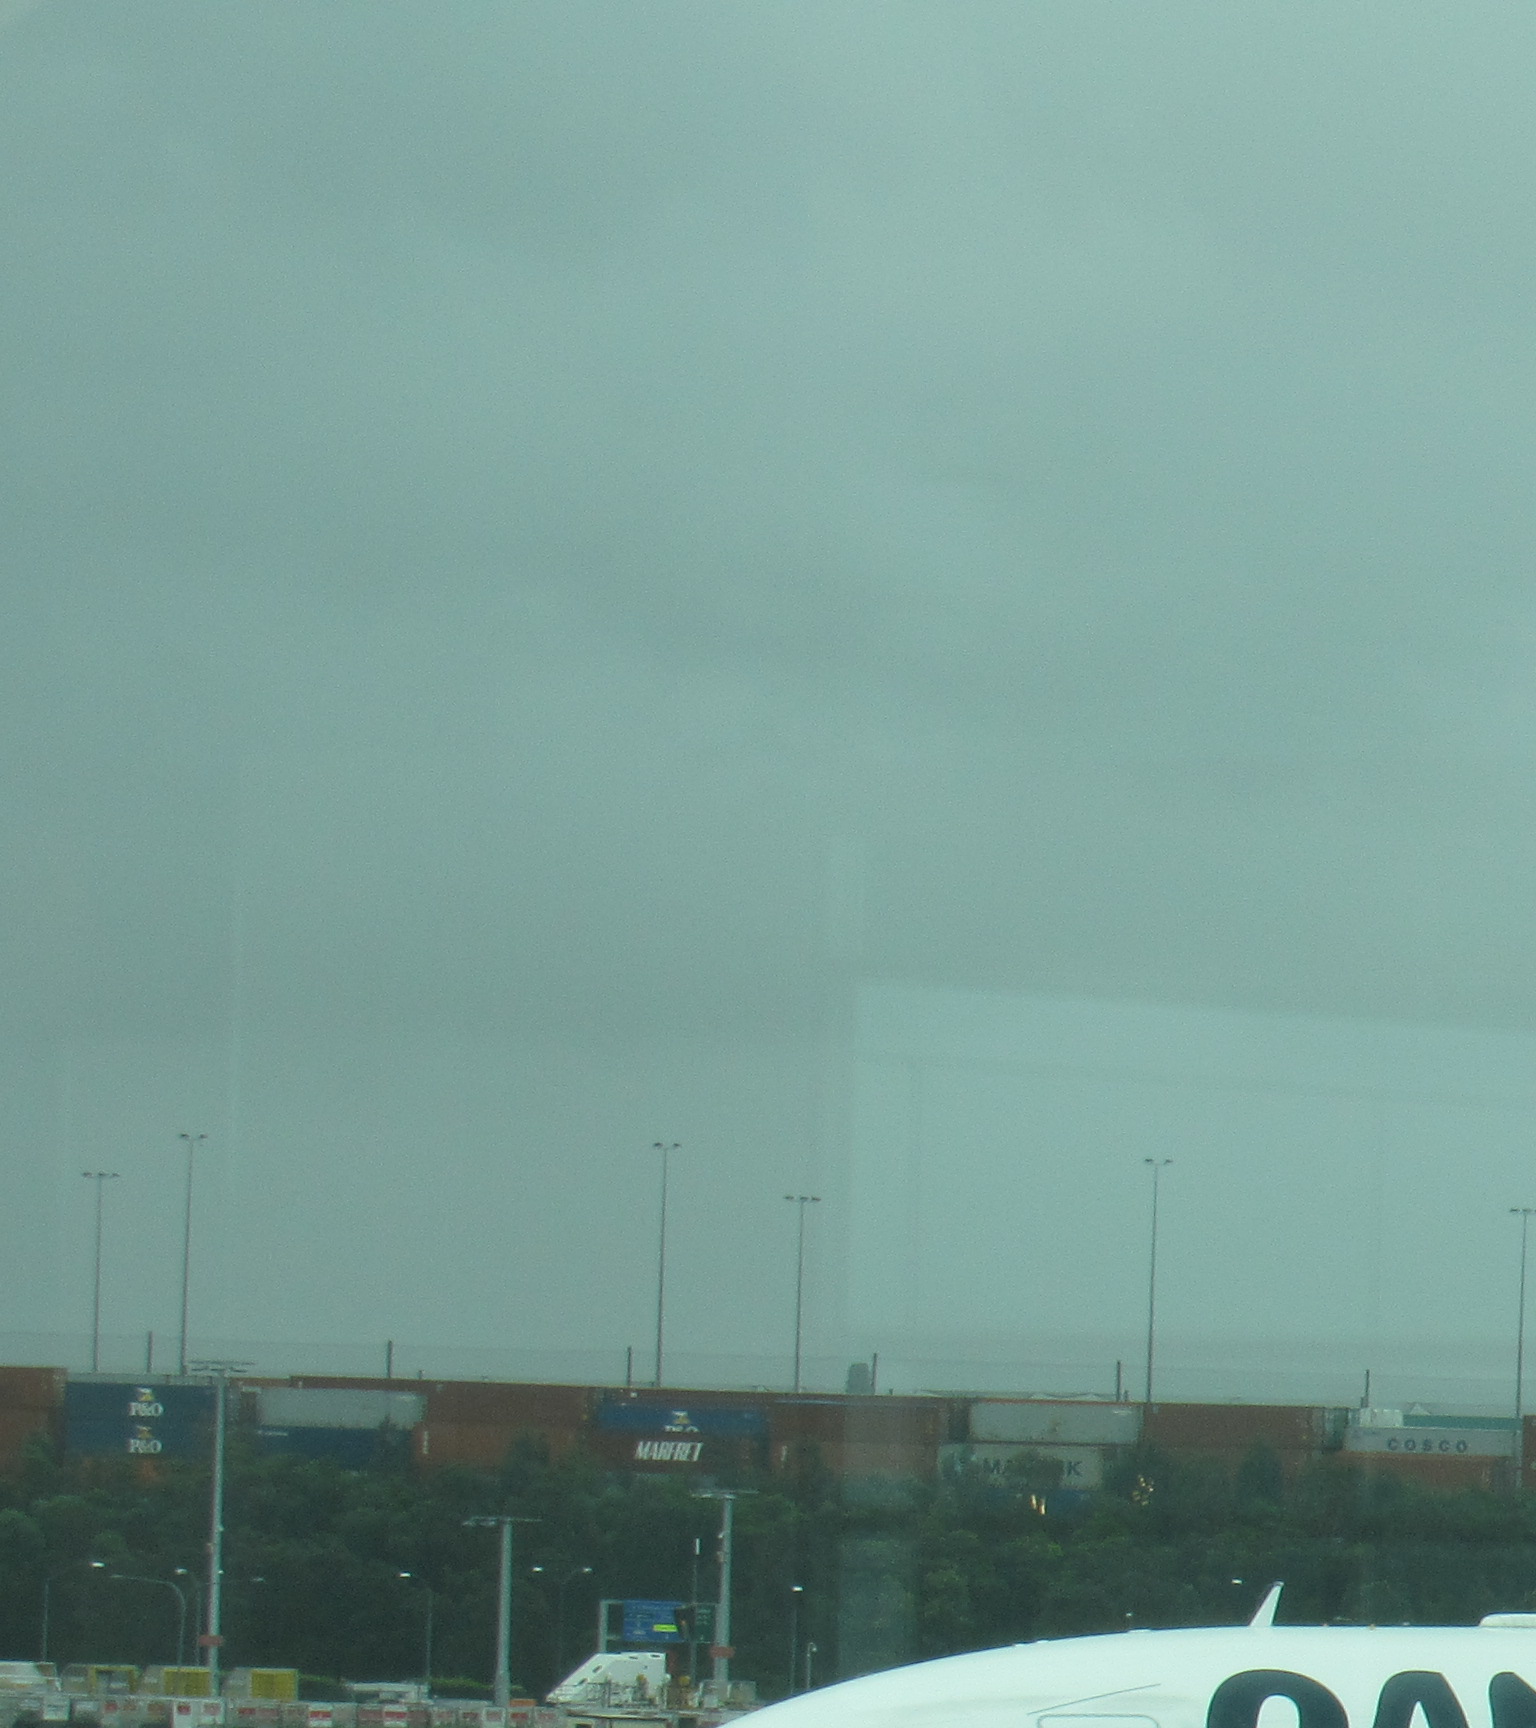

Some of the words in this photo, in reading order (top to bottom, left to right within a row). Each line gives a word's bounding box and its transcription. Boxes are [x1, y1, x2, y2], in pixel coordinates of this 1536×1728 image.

[129, 1402, 164, 1417] P&O
[129, 1439, 163, 1454] P&O
[1387, 1438, 1468, 1453] COSCO
